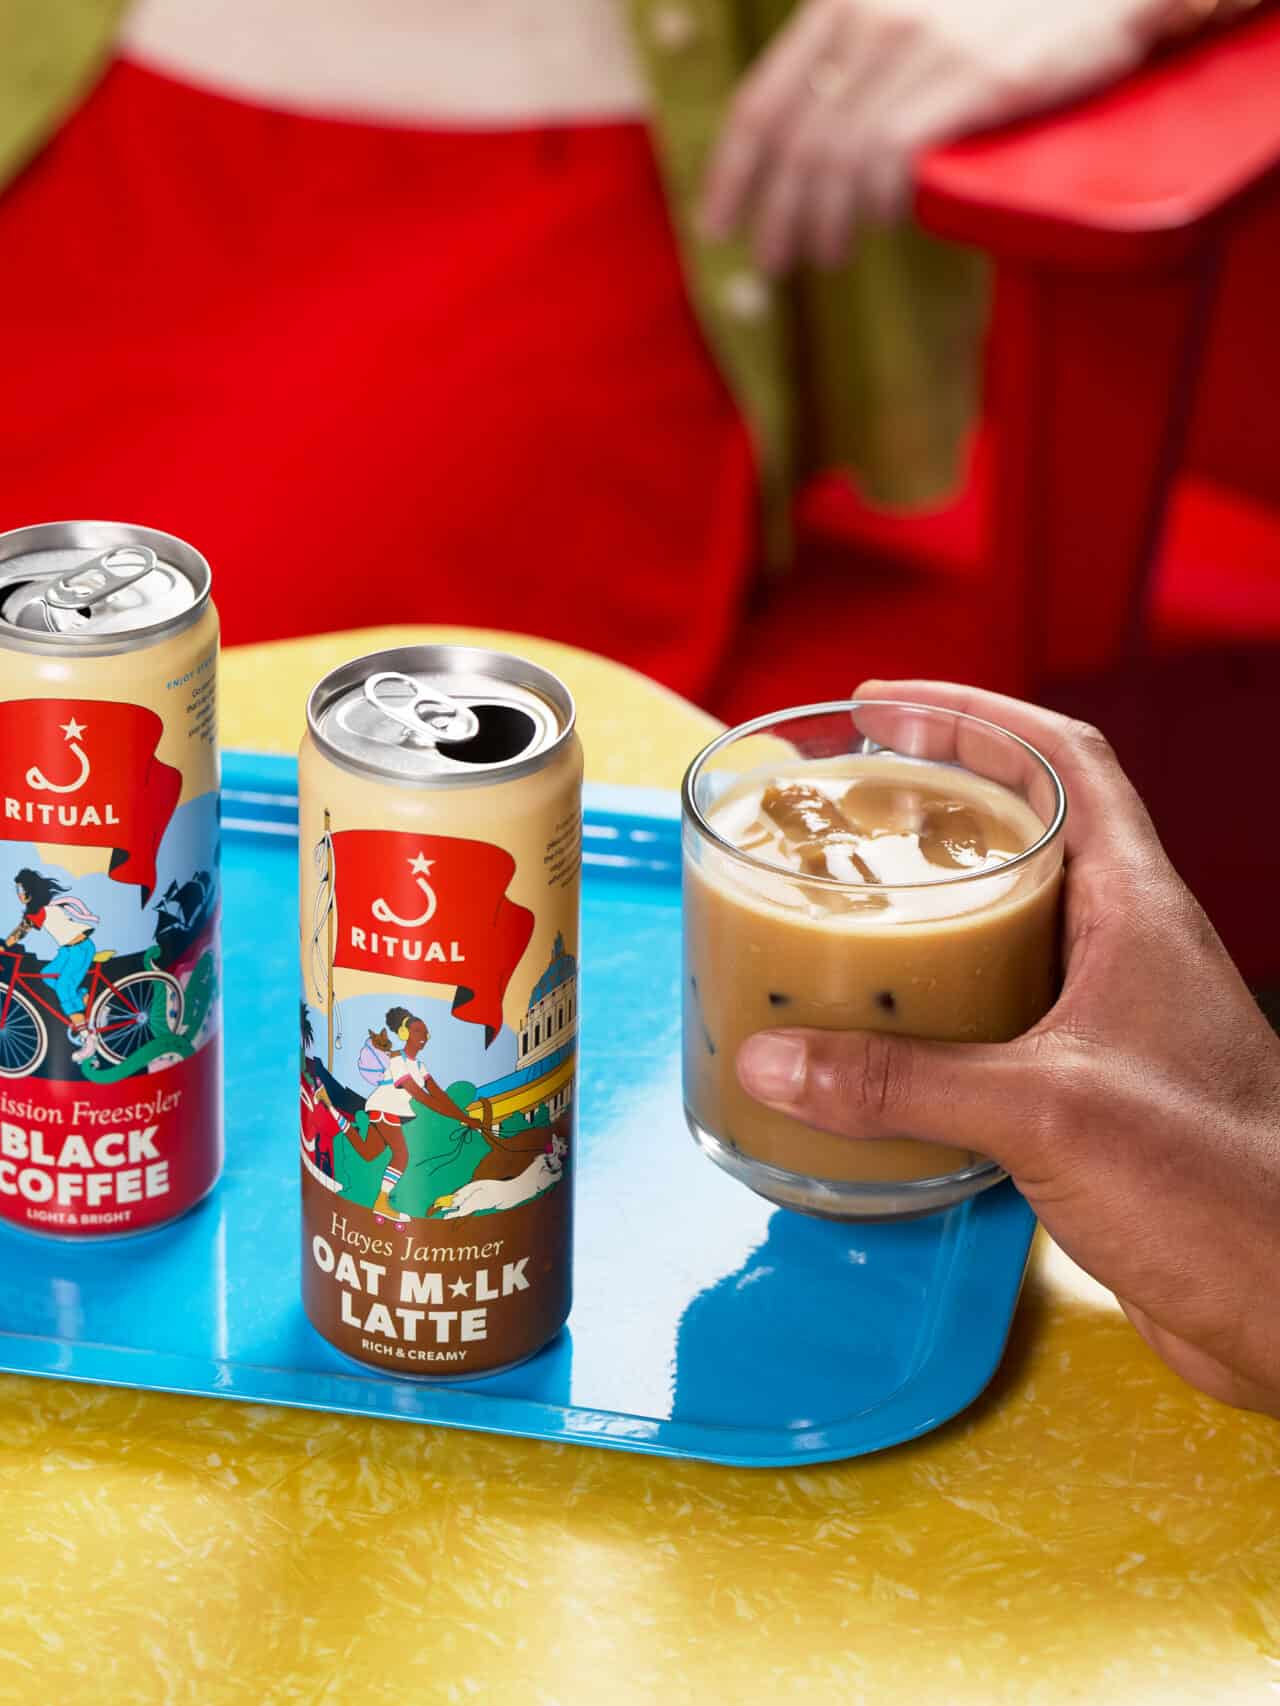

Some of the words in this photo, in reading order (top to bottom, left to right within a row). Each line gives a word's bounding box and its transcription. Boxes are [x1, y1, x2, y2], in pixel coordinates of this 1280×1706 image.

[5, 797, 120, 826] RITUAL
[351, 926, 465, 962] RITUAL
[72, 1090, 182, 1126] Freestyler
[0, 1121, 160, 1169] BLACK
[26, 1208, 66, 1224] LIGHT
[67, 1213, 78, 1225] &
[80, 1210, 132, 1225] BRIGHT
[331, 1212, 394, 1257] Hayes
[400, 1236, 505, 1263] Jammer
[312, 1234, 387, 1297] OAT
[341, 1289, 488, 1344] LATTE
[361, 1338, 394, 1356] RICH
[396, 1347, 406, 1358] &
[407, 1349, 467, 1361] CREAMY
